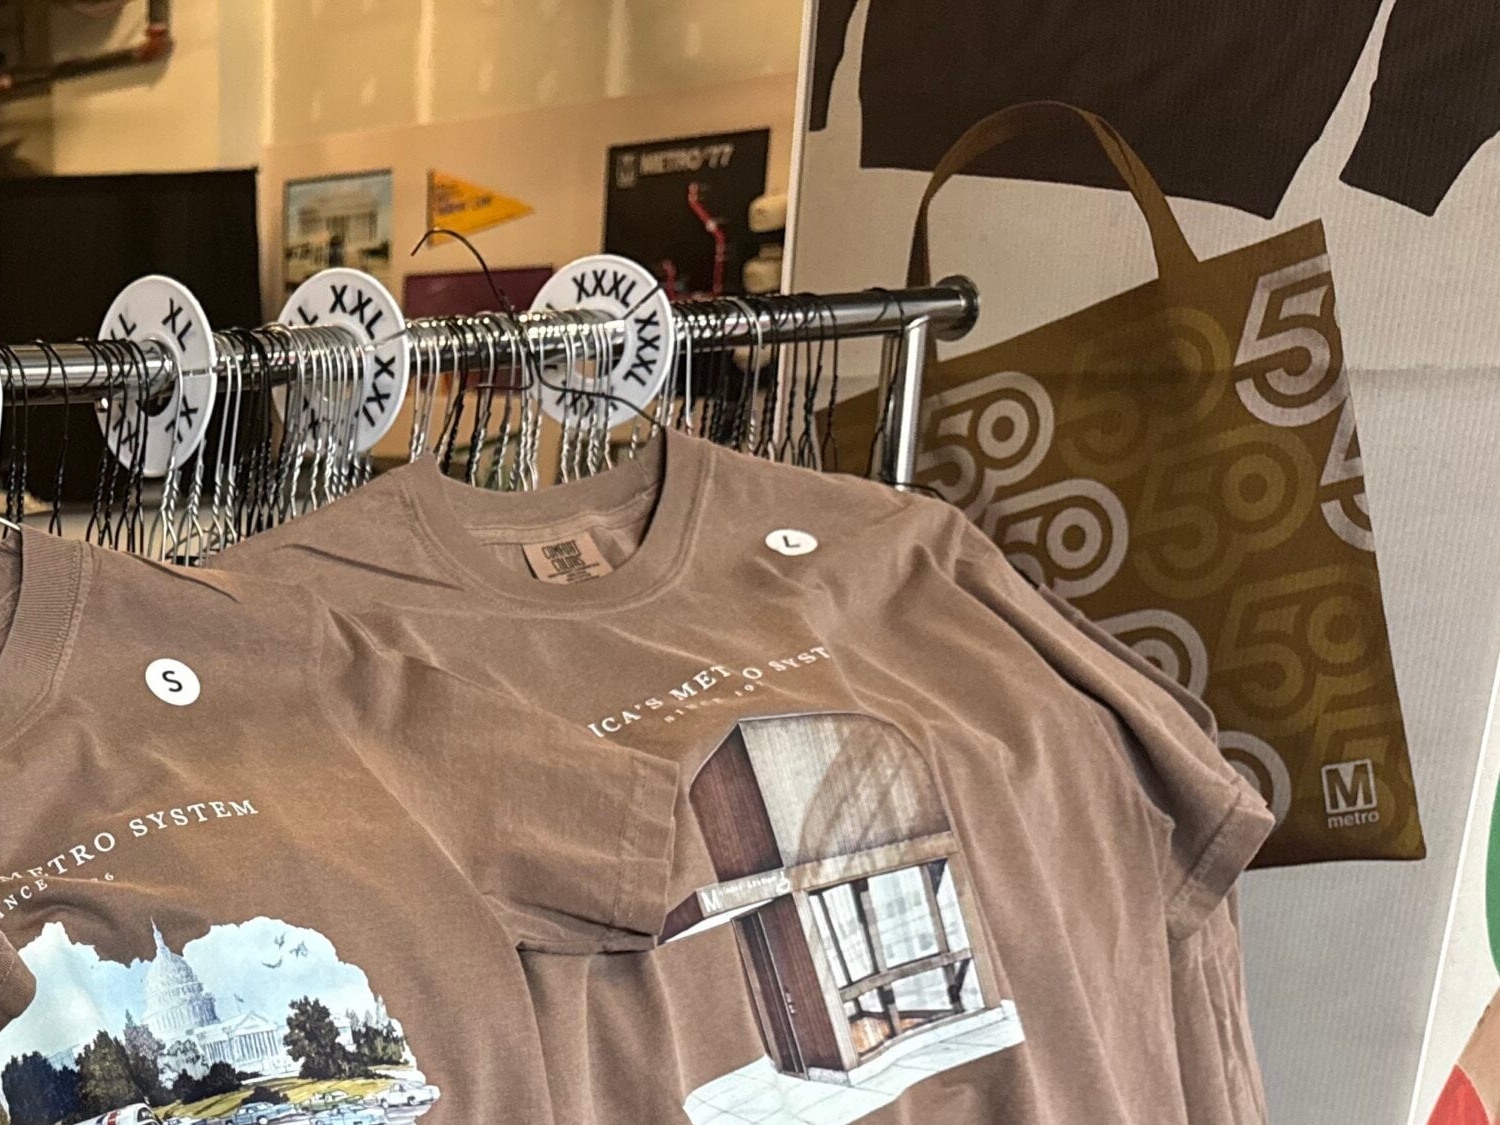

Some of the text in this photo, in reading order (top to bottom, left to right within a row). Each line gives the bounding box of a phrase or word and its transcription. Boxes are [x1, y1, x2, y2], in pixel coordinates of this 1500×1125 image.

[572, 269, 627, 309] XXXL
[162, 298, 192, 352] XL
[329, 285, 383, 341] XXL
[622, 310, 661, 387] XXXL
[783, 535, 801, 548] L
[162, 670, 183, 692] S
[1325, 764, 1373, 810] M
[129, 799, 259, 838] SYSTEM
[1328, 811, 1380, 829] metro
